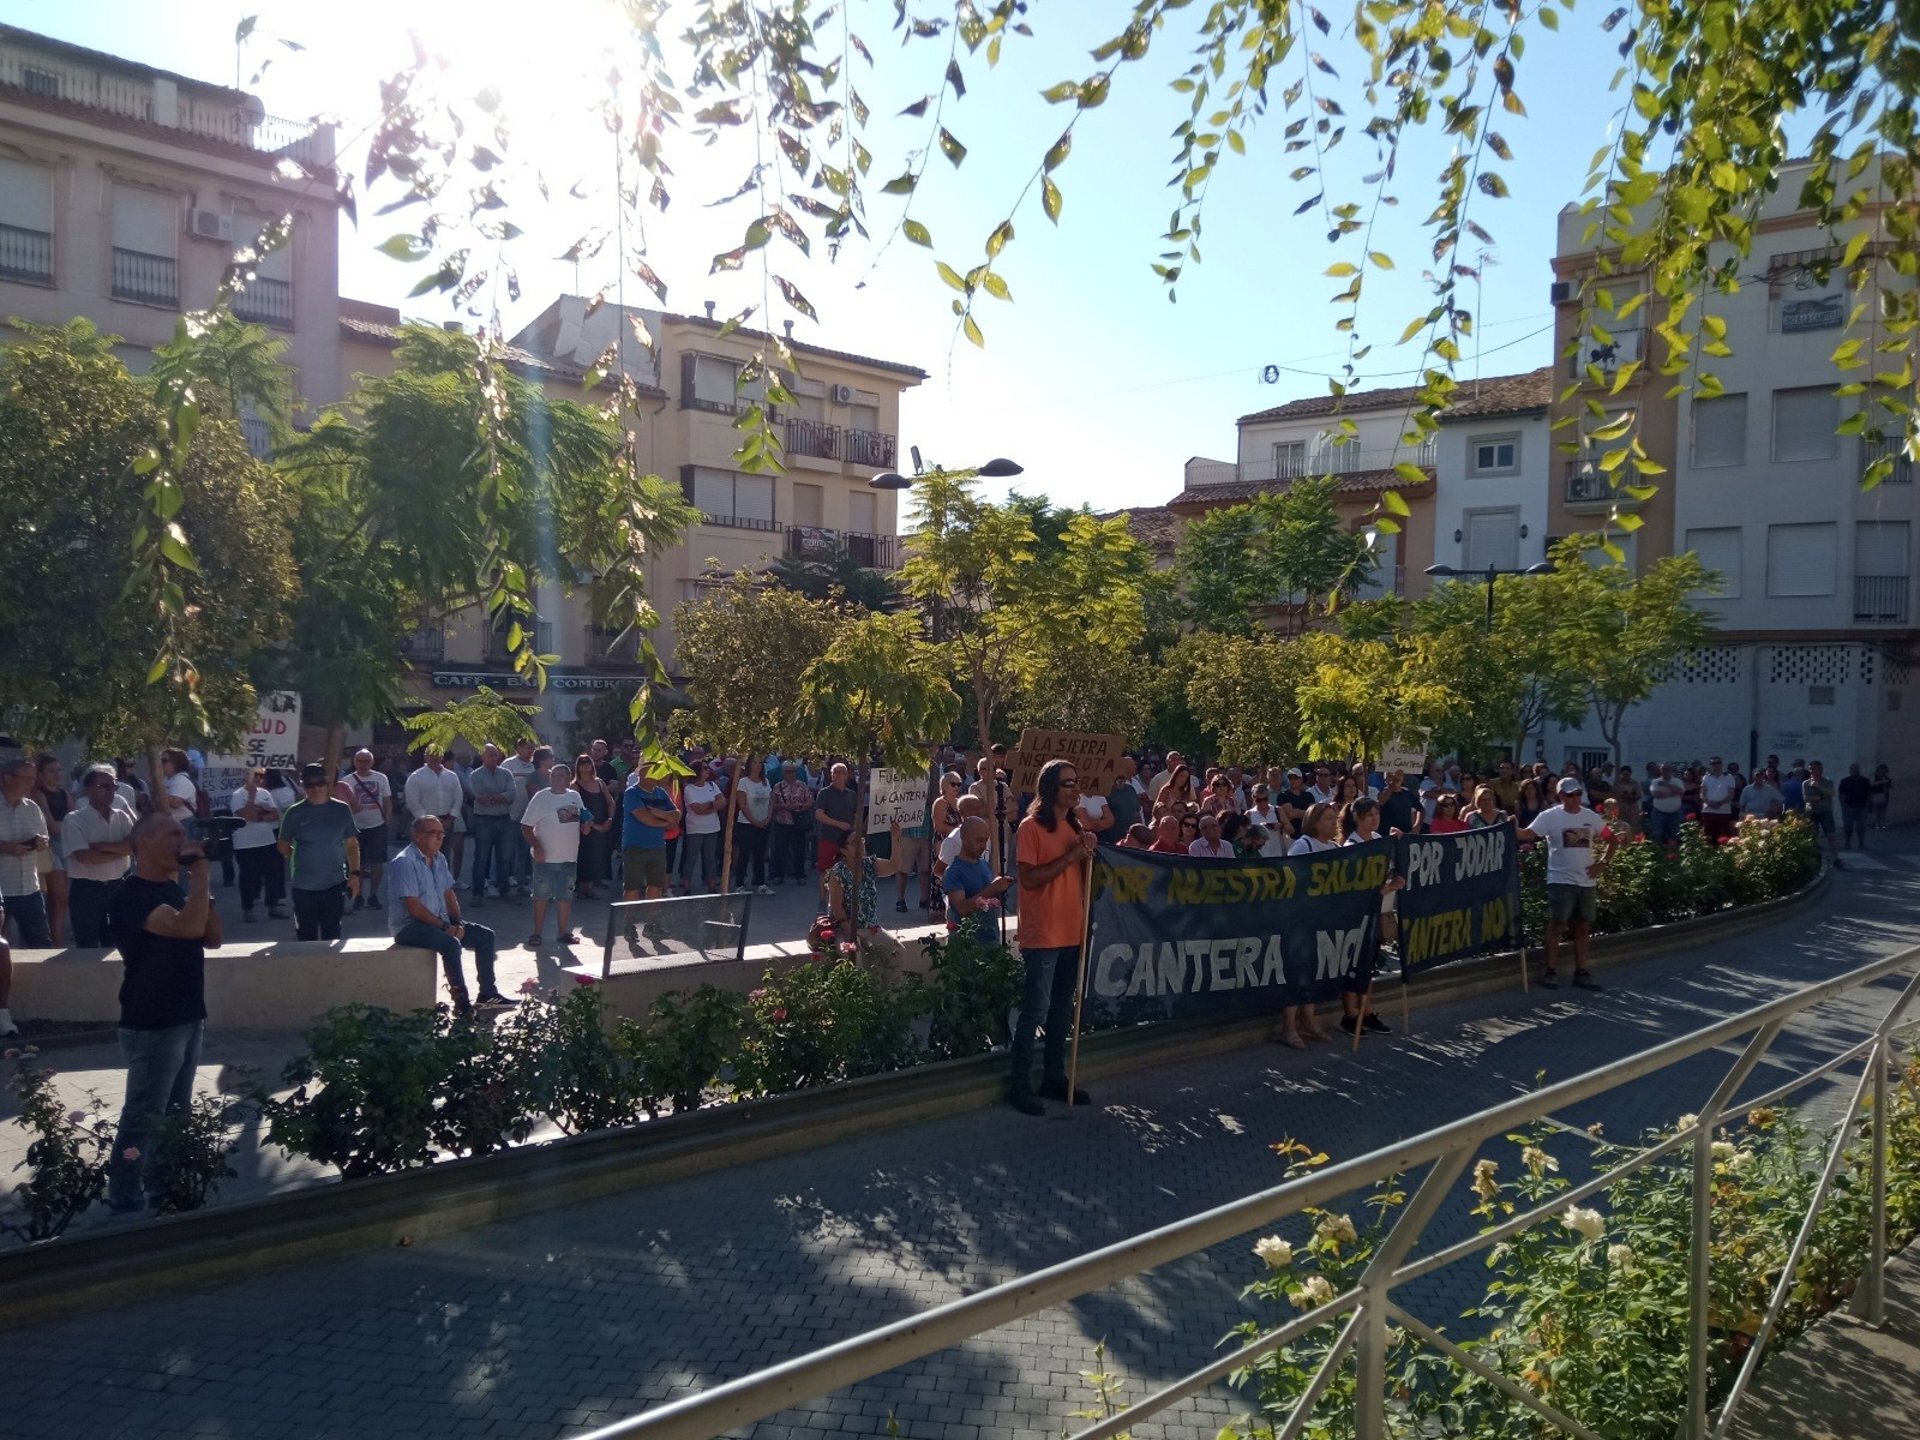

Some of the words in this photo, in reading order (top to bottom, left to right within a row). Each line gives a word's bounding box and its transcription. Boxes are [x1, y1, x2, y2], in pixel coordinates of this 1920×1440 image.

[272, 694, 297, 713] LA
[246, 719, 287, 735] LUD
[248, 739, 267, 752] SE
[1032, 737, 1051, 751] LA
[1056, 738, 1107, 756] SIERRA
[246, 754, 296, 768] JUEGA
[1021, 772, 1036, 786] NI
[874, 794, 887, 806] LA
[889, 791, 927, 803] CANTERA
[873, 814, 887, 826] DE
[1406, 841, 1444, 891] POR
[1454, 831, 1506, 881] JODAR
[1092, 862, 1155, 905] POR
[1167, 866, 1297, 905] NUESTRA
[1307, 854, 1388, 897] SALUD
[1315, 915, 1369, 980] NO!
